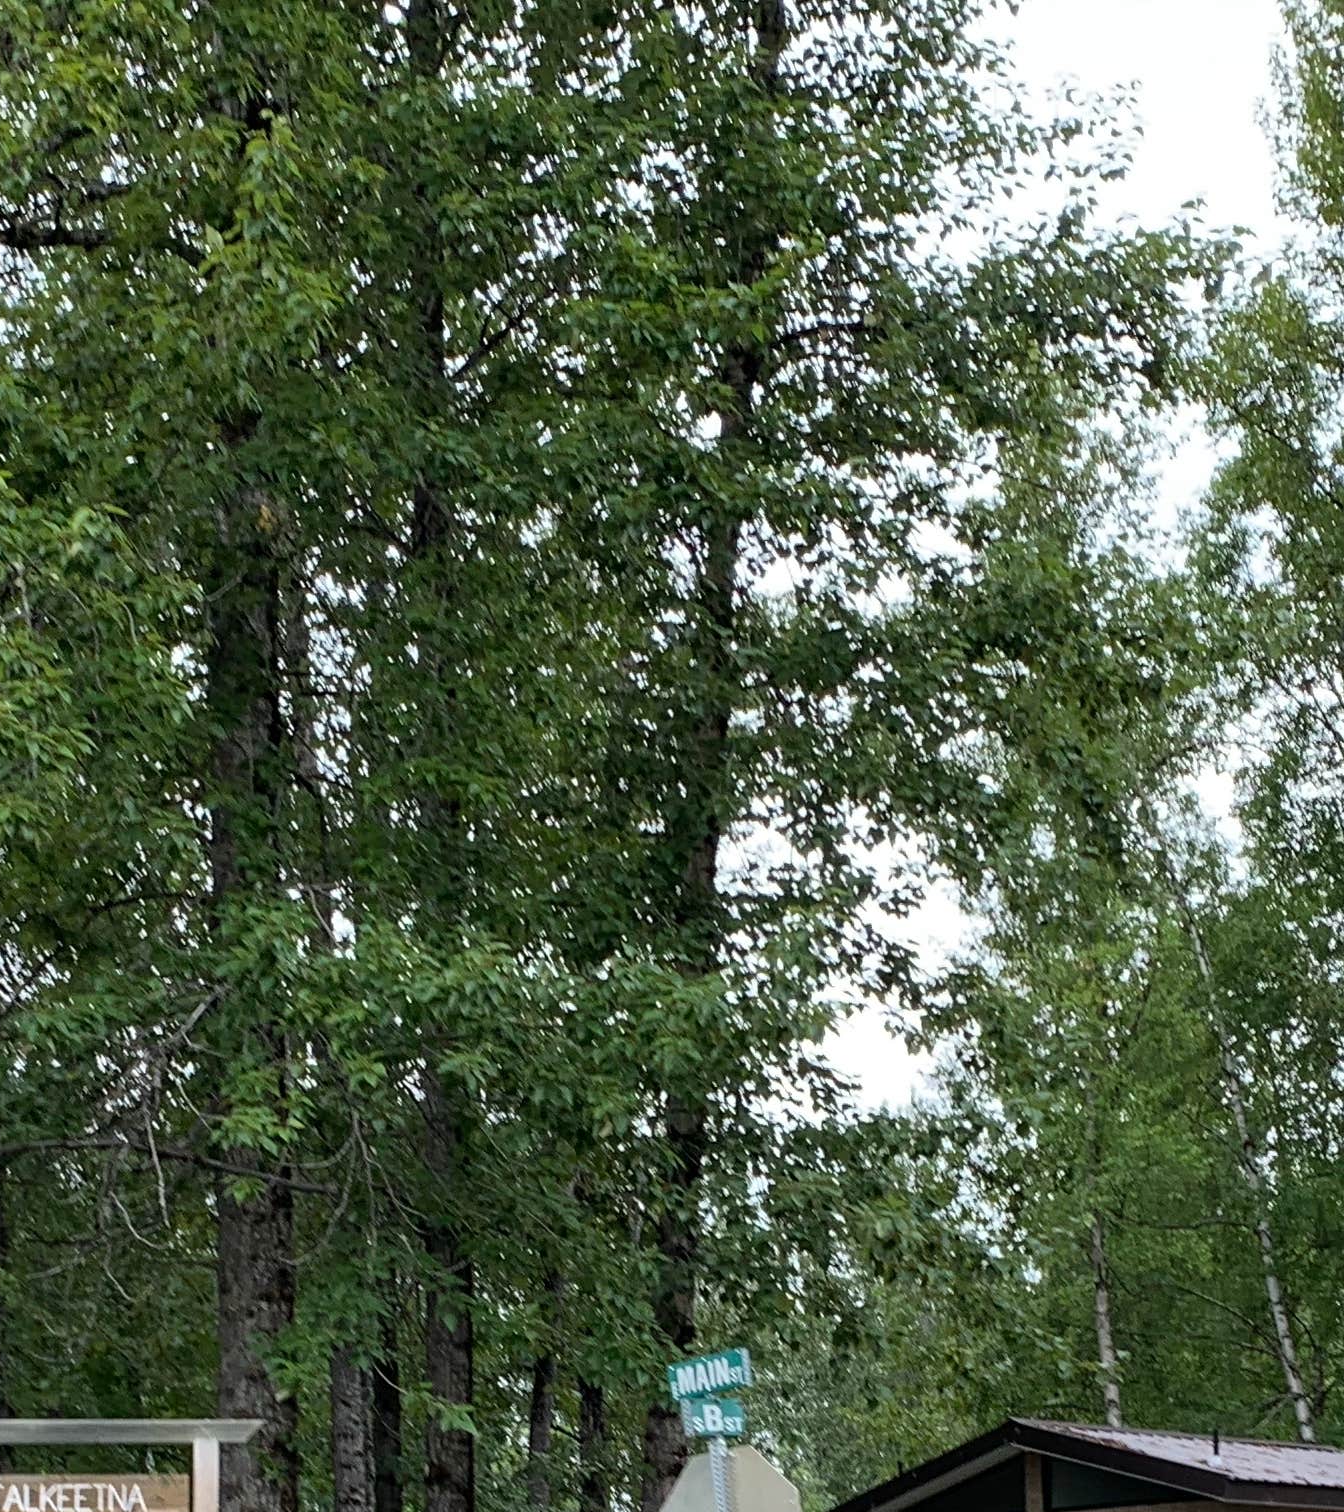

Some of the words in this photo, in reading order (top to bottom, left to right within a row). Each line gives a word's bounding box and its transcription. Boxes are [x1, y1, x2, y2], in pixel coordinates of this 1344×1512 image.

[677, 1357, 732, 1395] MAIN
[702, 1404, 724, 1432] B
[723, 1416, 743, 1432] ST
